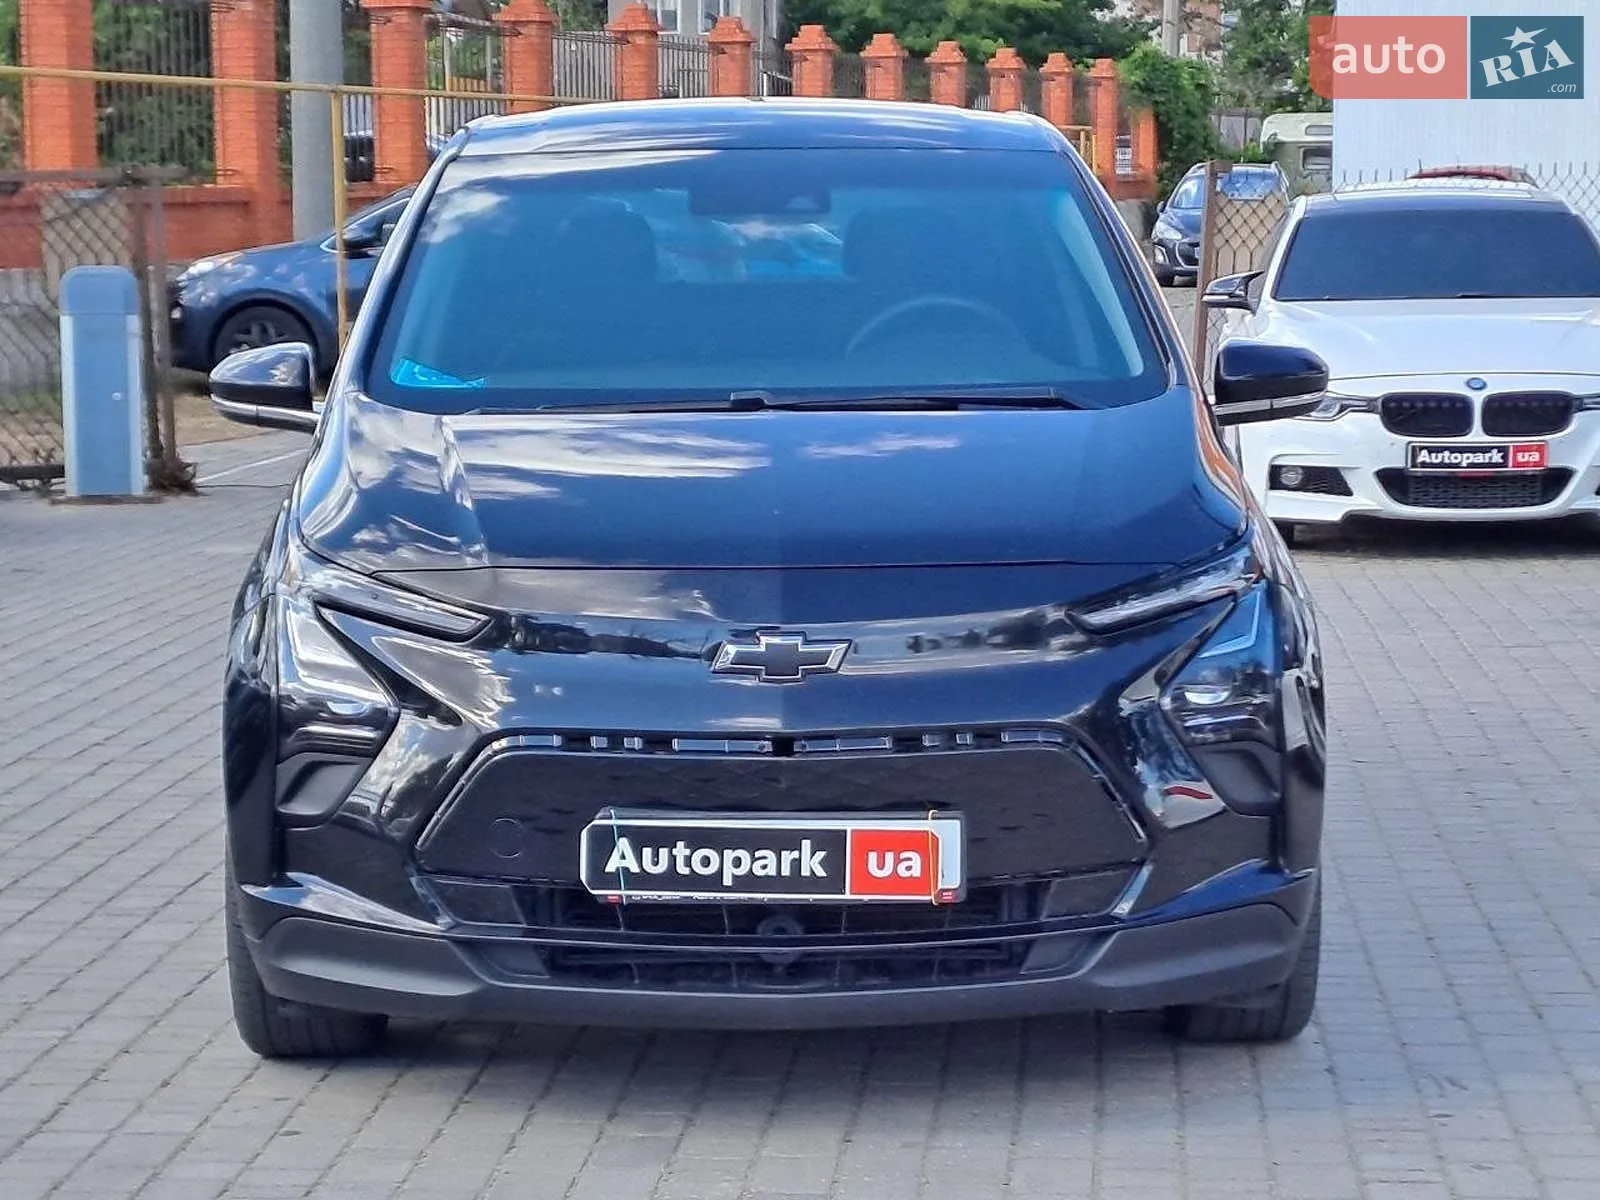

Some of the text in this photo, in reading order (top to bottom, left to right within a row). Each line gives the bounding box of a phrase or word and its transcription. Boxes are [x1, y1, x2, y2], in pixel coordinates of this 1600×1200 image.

[1416, 448, 1540, 467] Autopark ua
[604, 837, 922, 886] Autopark ua
